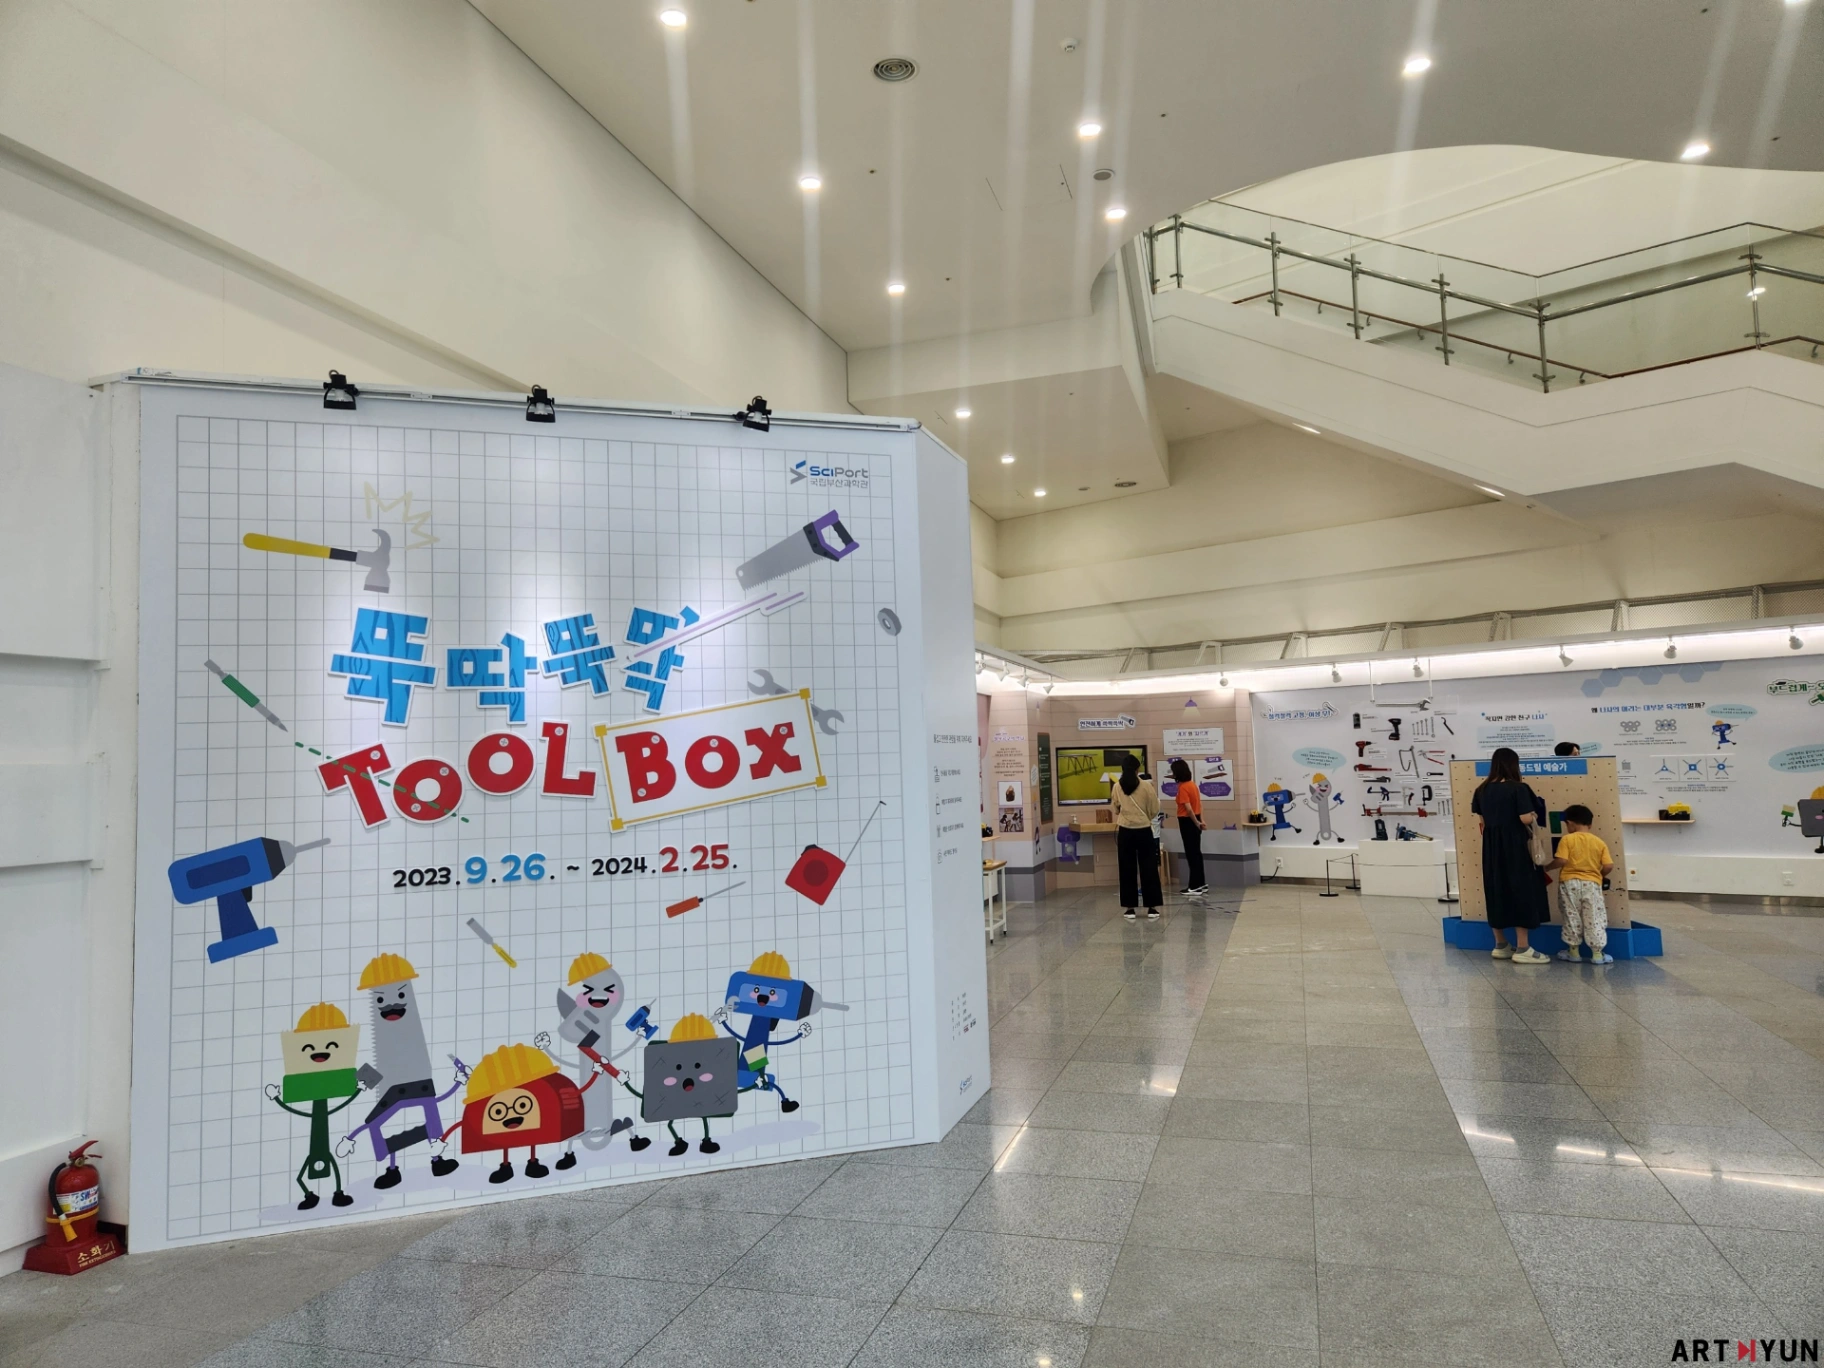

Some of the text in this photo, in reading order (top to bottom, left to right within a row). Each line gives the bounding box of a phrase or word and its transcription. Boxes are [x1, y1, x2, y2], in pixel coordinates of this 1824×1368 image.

[809, 466, 869, 478] SciPort
[810, 478, 868, 489] 국립부산과학관
[330, 605, 700, 725] 뚝딱뚝딱
[1599, 705, 1620, 713] 나사의
[1543, 762, 1568, 772] 예술가
[318, 722, 802, 827] TOOL BOX
[78, 1240, 115, 1263] 소화기
